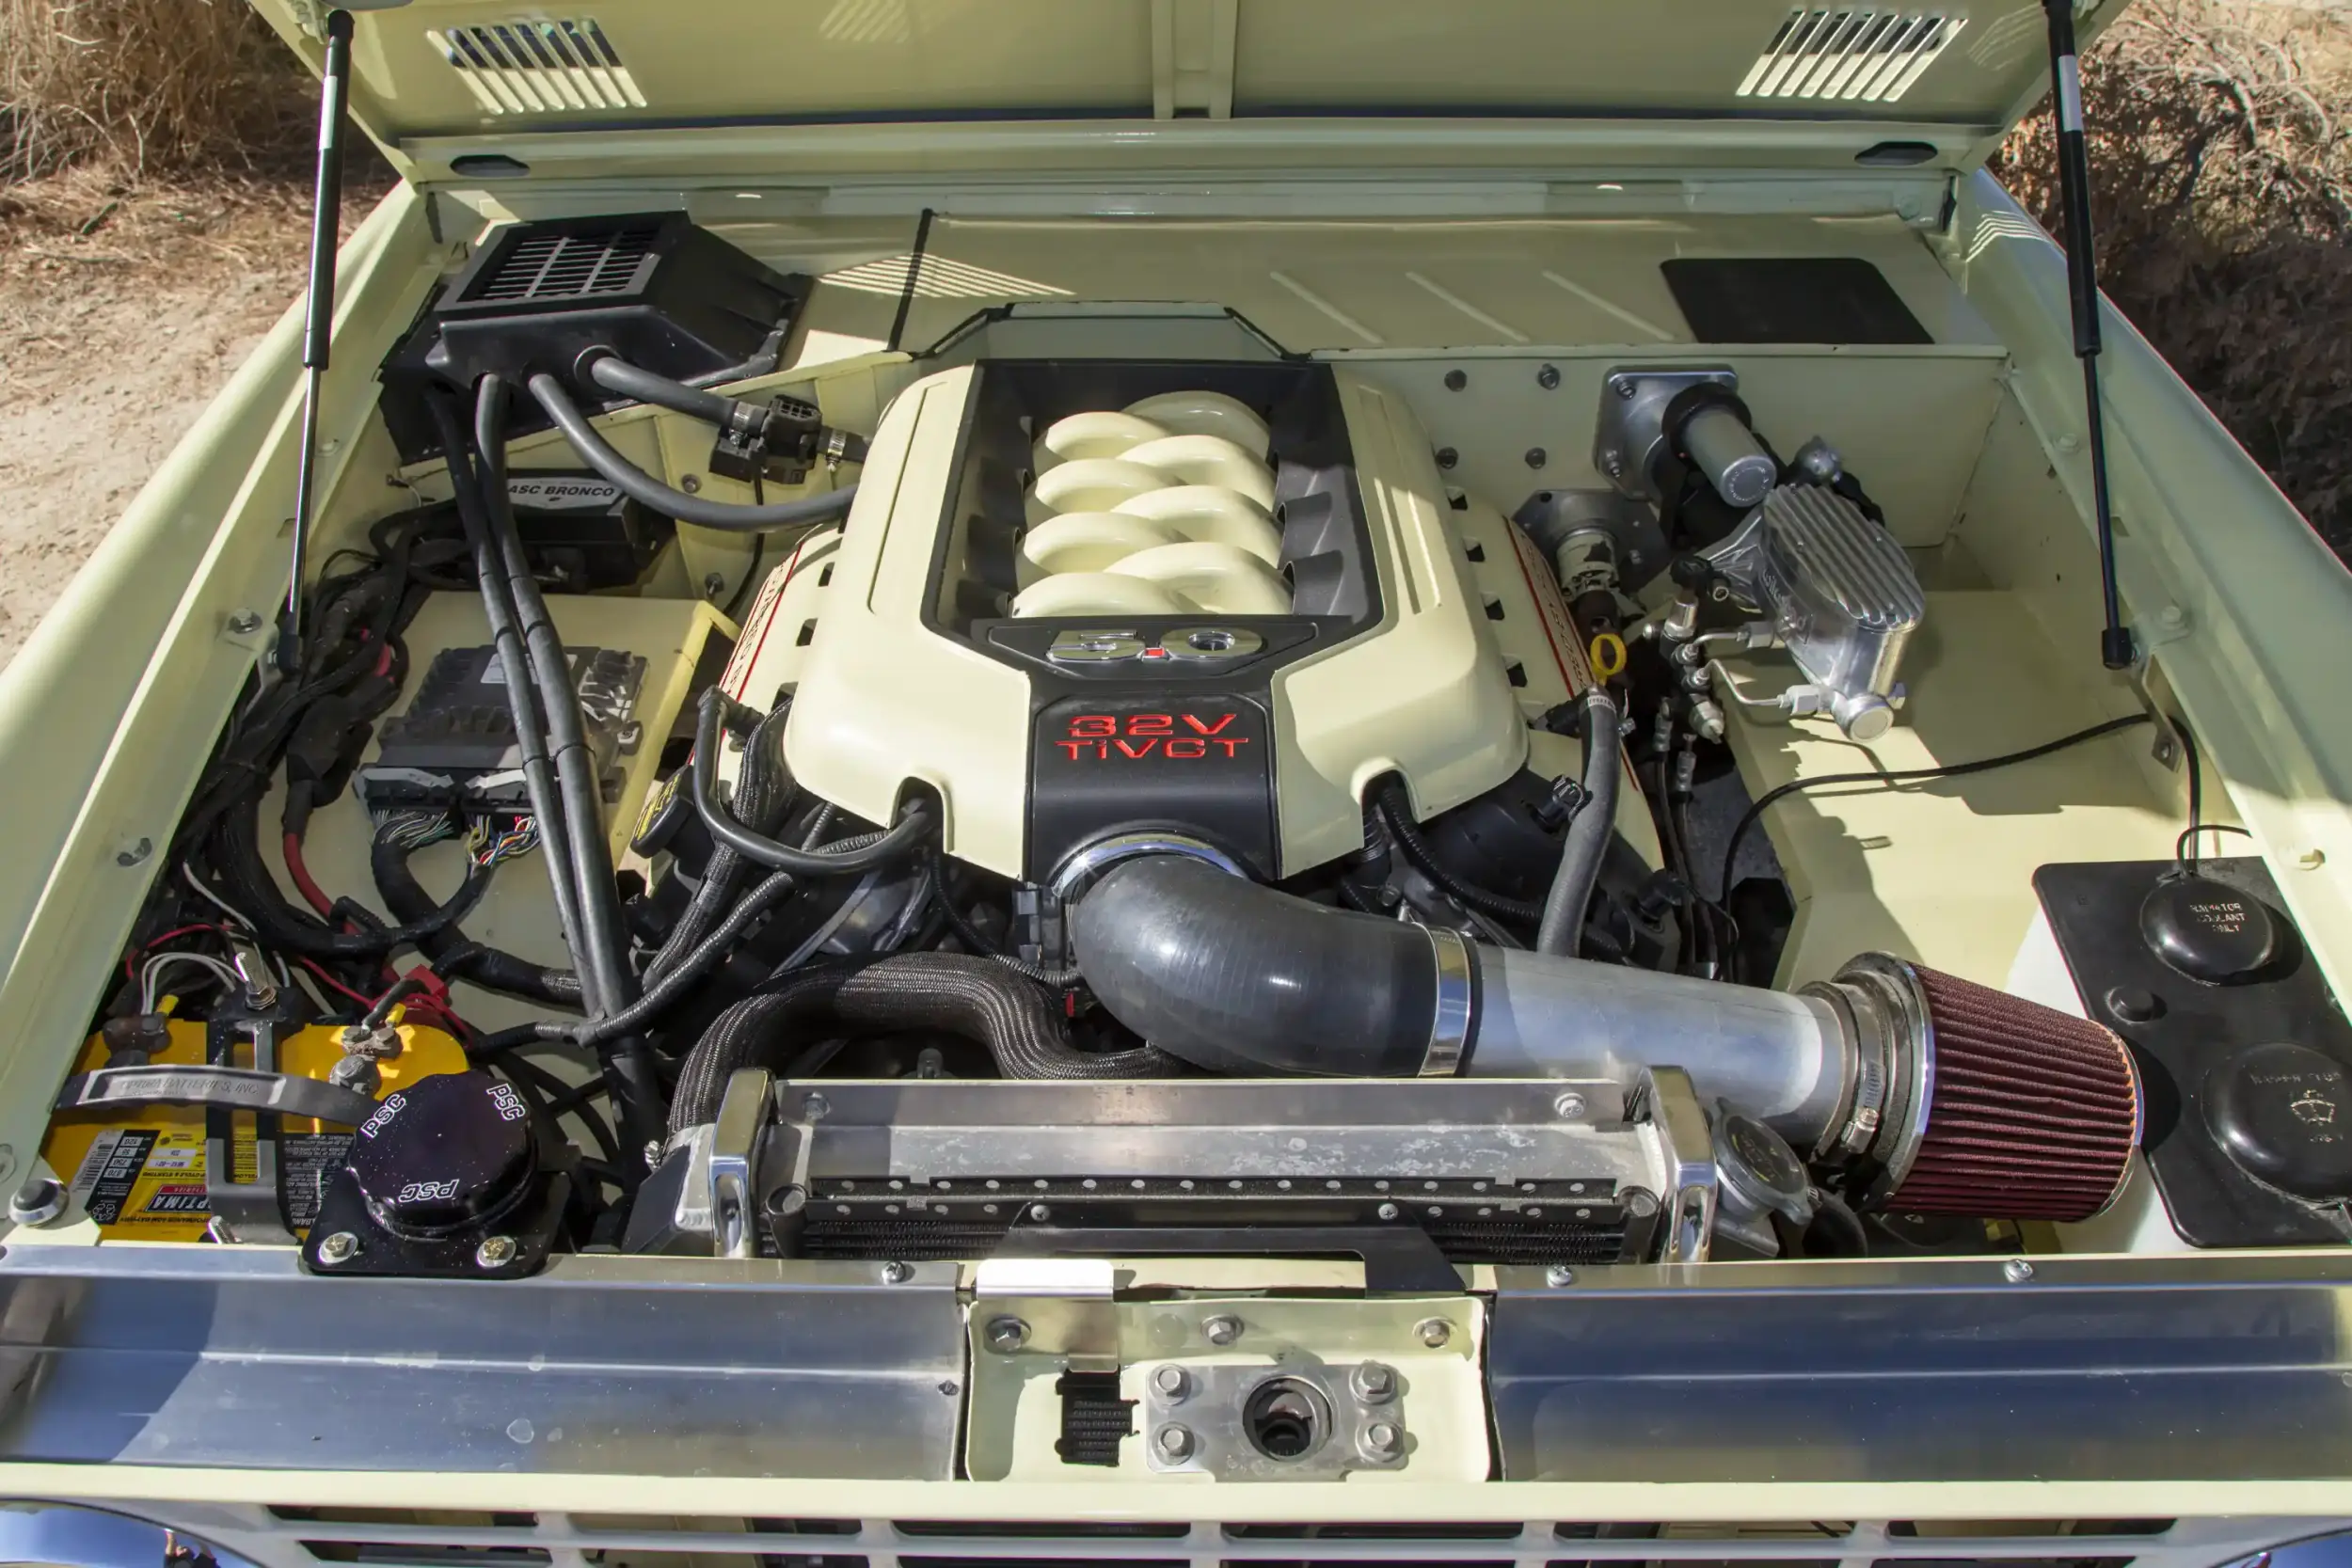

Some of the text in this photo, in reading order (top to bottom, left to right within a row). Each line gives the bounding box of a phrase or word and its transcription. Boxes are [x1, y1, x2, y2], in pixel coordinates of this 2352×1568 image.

[508, 484, 614, 497] ASC BRONCO
[1046, 626, 1266, 661] 5.0
[1069, 713, 1236, 737] 32V
[486, 1083, 526, 1121] PSC
[360, 1093, 406, 1139] PSC
[155, 1195, 208, 1209] PTIMA
[398, 1179, 459, 1203] PSC
